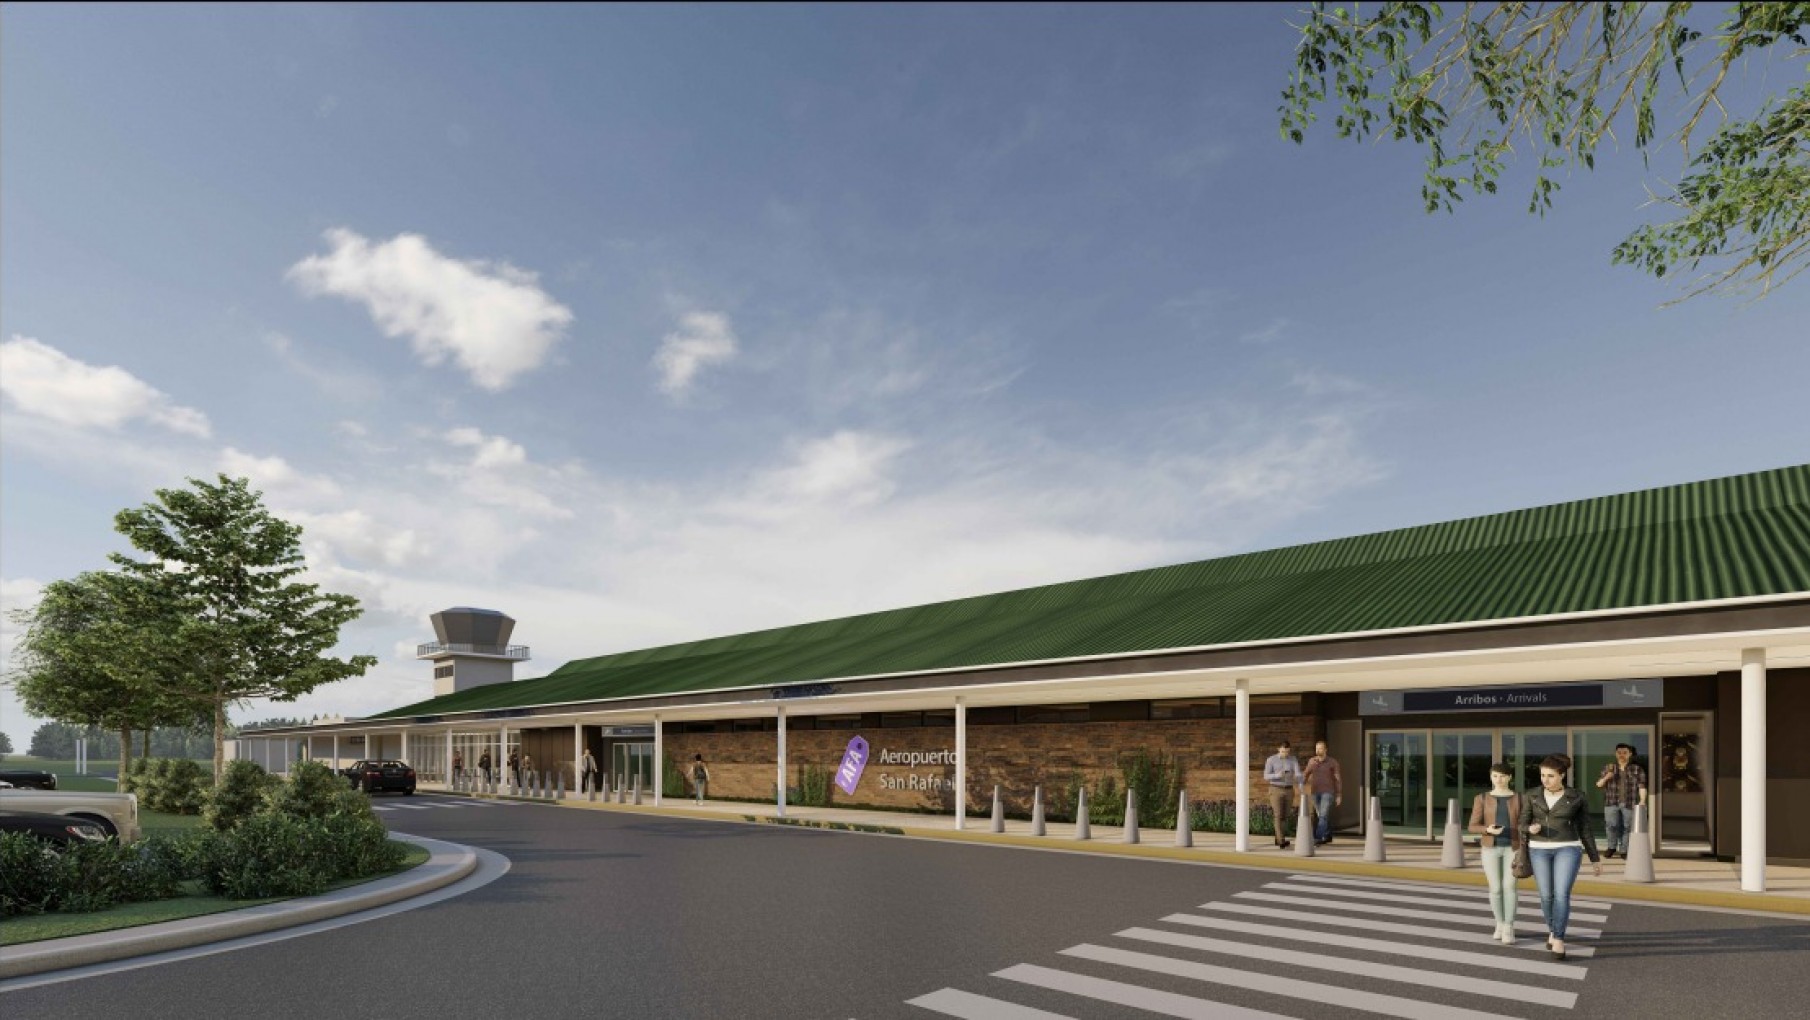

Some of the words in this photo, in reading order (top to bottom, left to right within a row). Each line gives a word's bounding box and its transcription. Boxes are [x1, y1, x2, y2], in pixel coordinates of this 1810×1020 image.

[1455, 694, 1498, 705] Arribos
[1506, 692, 1548, 703] Arrivals
[880, 748, 957, 767] Aeropuerto
[880, 774, 904, 790] San
